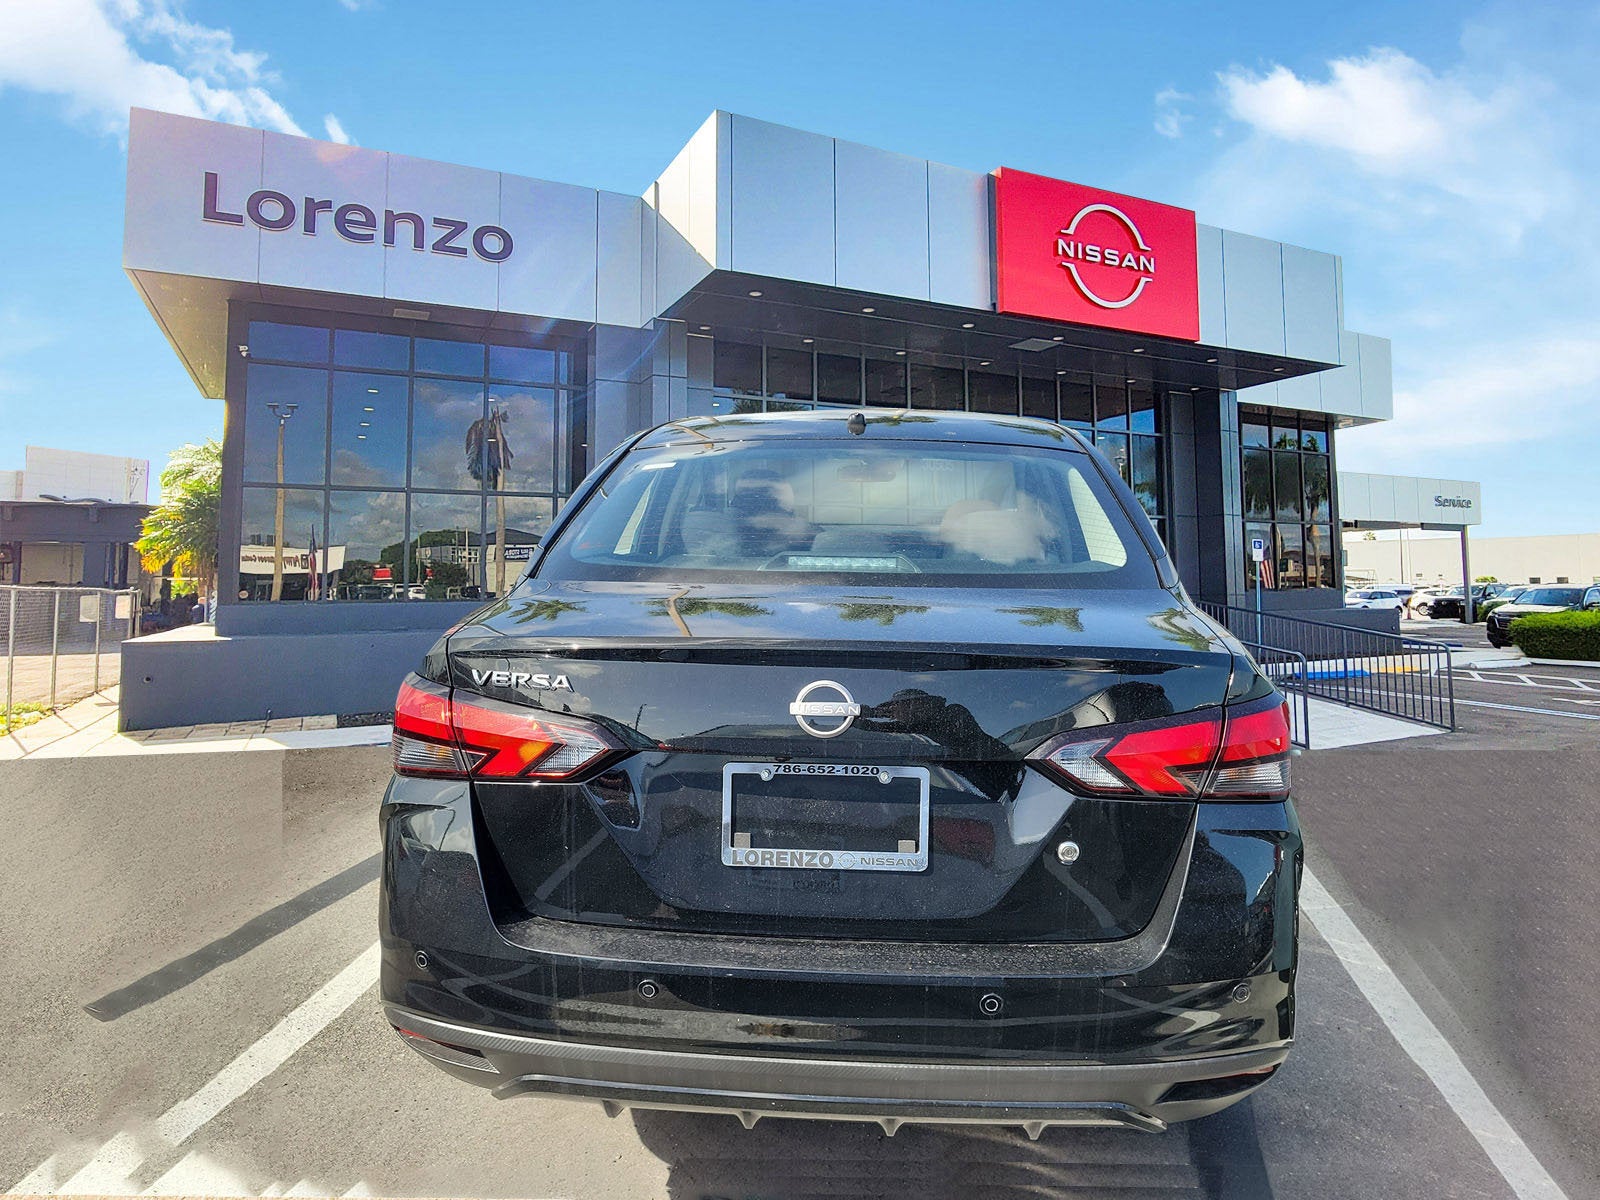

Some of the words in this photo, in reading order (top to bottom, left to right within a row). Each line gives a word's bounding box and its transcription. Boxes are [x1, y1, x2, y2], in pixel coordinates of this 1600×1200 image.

[202, 171, 514, 262] Lorenzo
[1057, 238, 1155, 273] NISSAN
[1434, 495, 1472, 509] Service
[471, 669, 575, 693] VERSA
[773, 764, 880, 776] 786-652-1020
[731, 850, 834, 868] LORENZO
[860, 857, 918, 867] NISSAN
